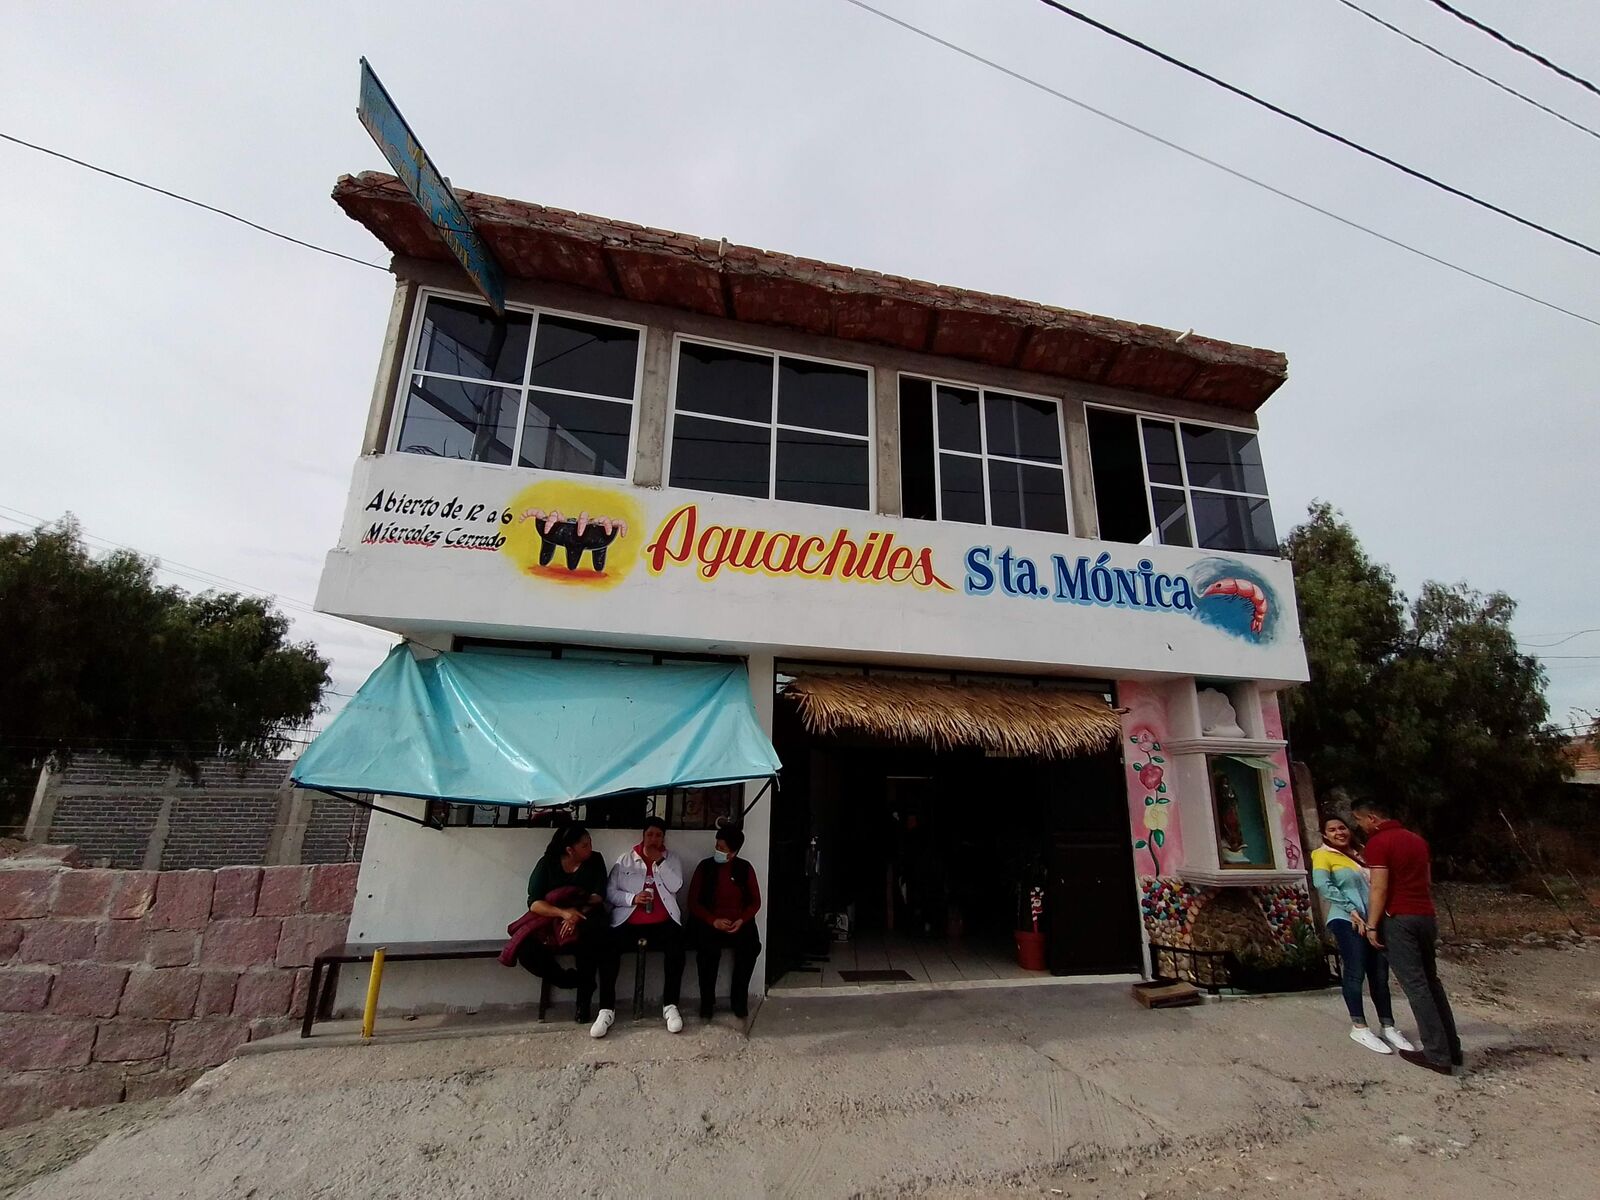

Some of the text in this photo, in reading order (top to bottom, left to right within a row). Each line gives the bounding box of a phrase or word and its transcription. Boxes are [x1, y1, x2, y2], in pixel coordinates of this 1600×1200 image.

[365, 489, 440, 516] Abierto
[464, 504, 485, 521] 12
[486, 510, 498, 523] a
[501, 507, 513, 524] 6
[444, 527, 507, 549] Cerrado
[647, 505, 955, 590] Aguachiles
[967, 547, 1048, 595] Sta.
